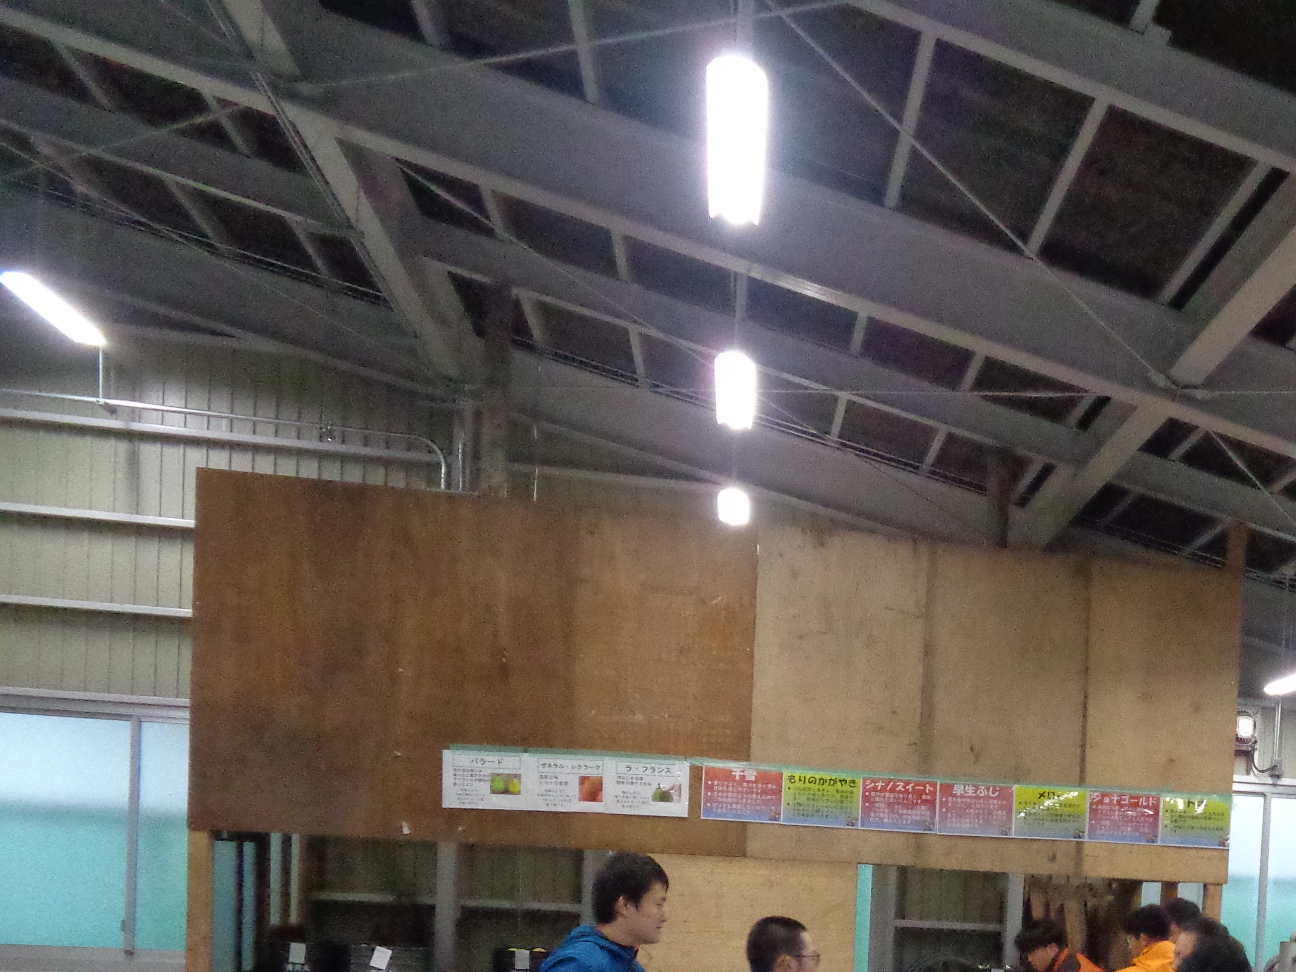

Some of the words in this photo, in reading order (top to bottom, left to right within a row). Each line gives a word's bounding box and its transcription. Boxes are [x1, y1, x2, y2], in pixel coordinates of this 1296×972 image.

[625, 764, 672, 774] ラ・フランス
[787, 775, 858, 788] もりのかがやき
[865, 780, 934, 794] シナノスイート
[952, 784, 1000, 797] 早生ふじ
